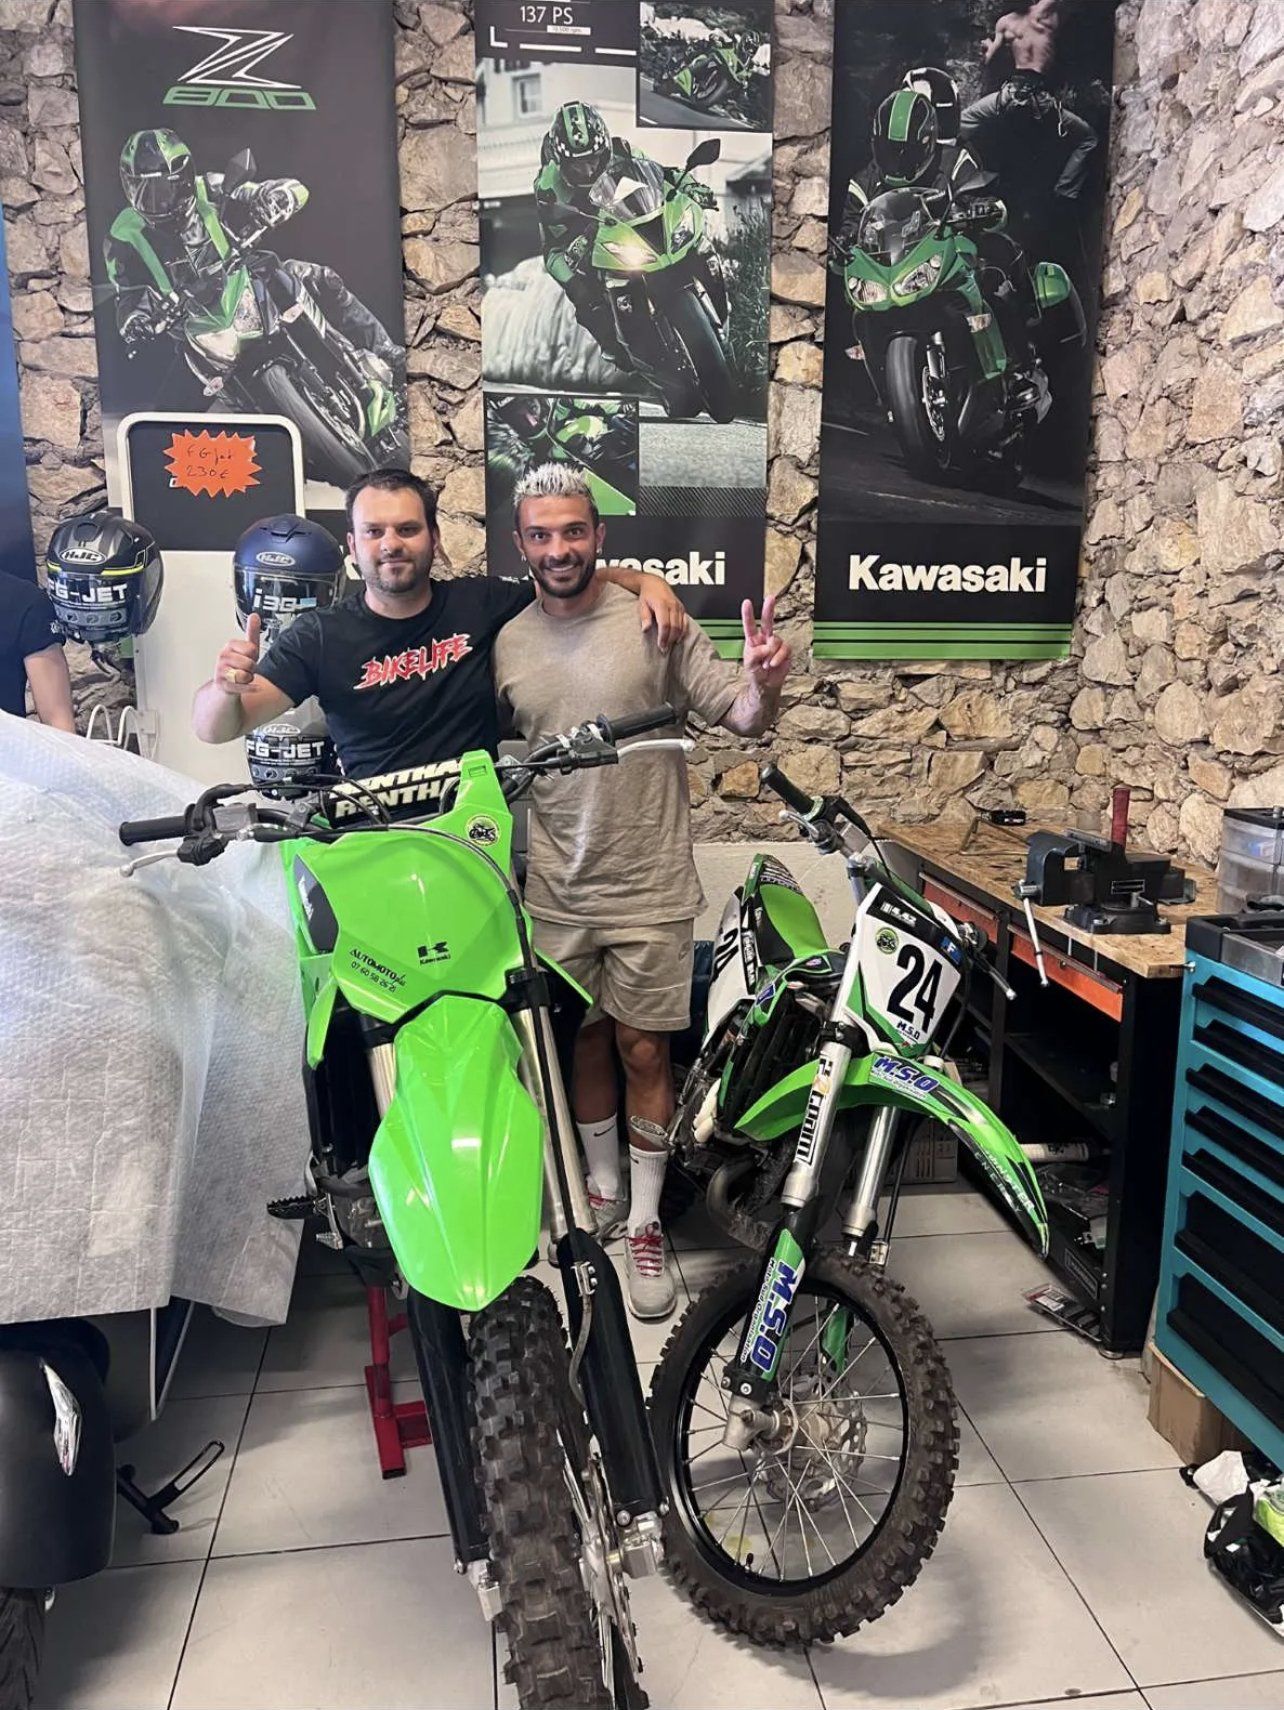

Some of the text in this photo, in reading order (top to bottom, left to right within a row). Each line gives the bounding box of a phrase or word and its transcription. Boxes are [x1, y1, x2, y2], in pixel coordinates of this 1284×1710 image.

[520, 6, 573, 25] 137 PS
[163, 86, 316, 110] 800
[63, 550, 100, 562] HJC
[848, 554, 1047, 593] Kawasaki
[353, 633, 474, 690] BIKELIFE
[246, 740, 324, 758] FG-JET
[886, 944, 942, 1034] 24
